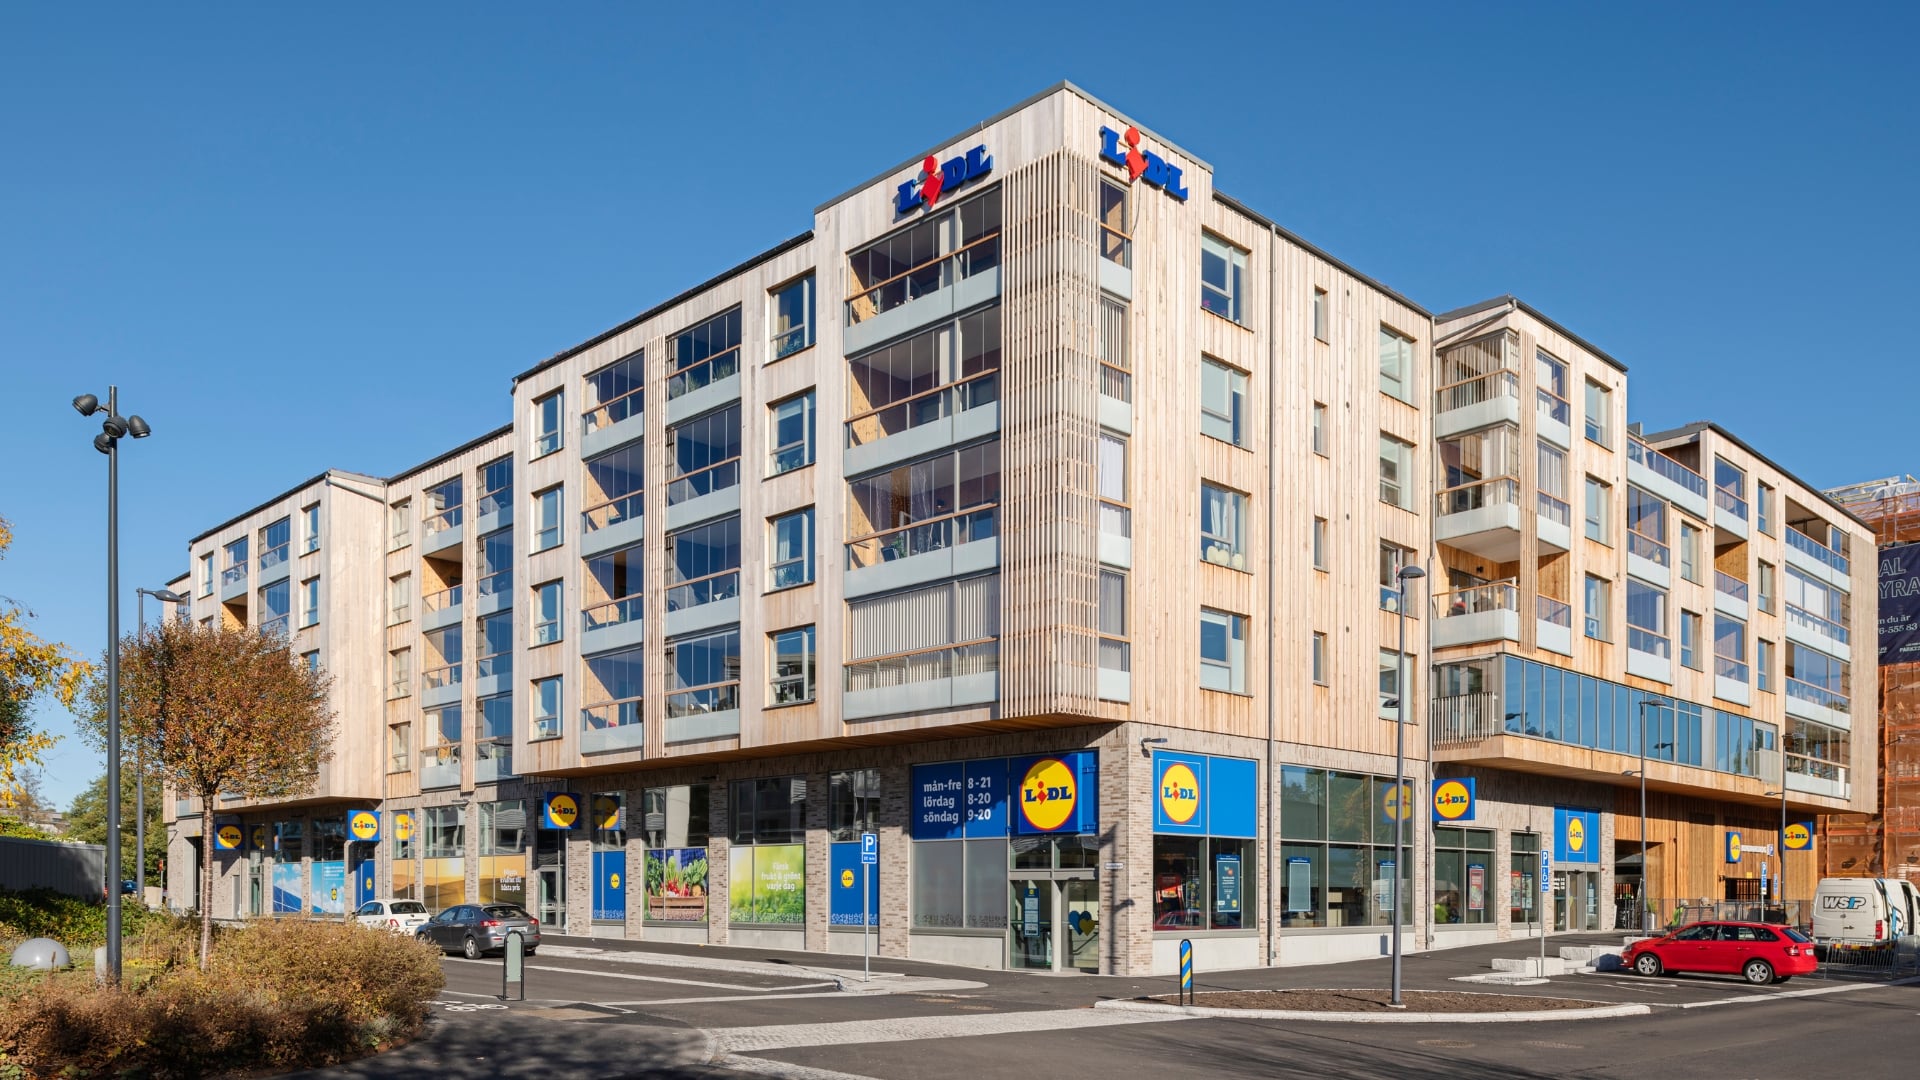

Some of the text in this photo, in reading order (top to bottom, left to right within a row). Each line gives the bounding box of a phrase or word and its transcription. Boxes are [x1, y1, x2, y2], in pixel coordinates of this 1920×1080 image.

[1887, 616, 1899, 624] du
[1906, 623, 1918, 631] 83
[923, 779, 962, 793] mån-fre
[923, 792, 991, 809] lördag 8-20
[923, 808, 991, 825] söndag 9-20
[865, 836, 874, 852] P
[1542, 851, 1548, 865] P
[783, 881, 795, 892] dag
